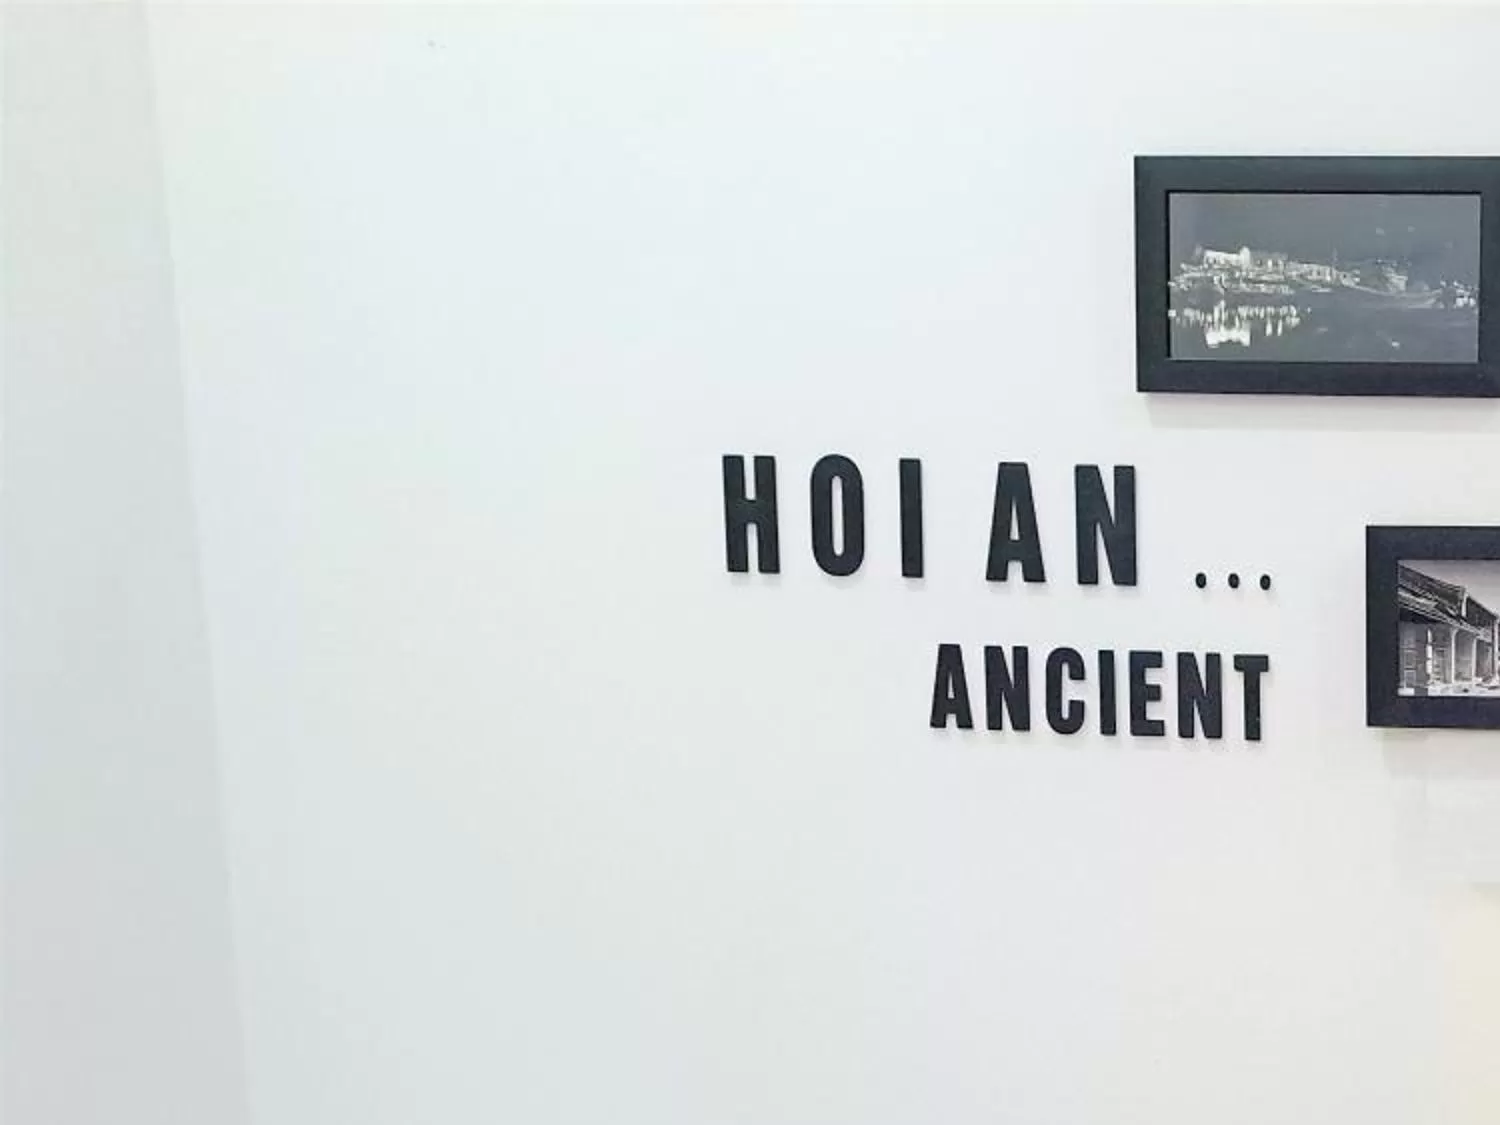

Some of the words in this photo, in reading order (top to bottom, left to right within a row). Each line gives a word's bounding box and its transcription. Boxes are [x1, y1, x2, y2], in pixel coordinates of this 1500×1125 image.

[722, 454, 924, 579] HOI
[985, 461, 1138, 587] AN
[929, 643, 1270, 742] ANCIENT
